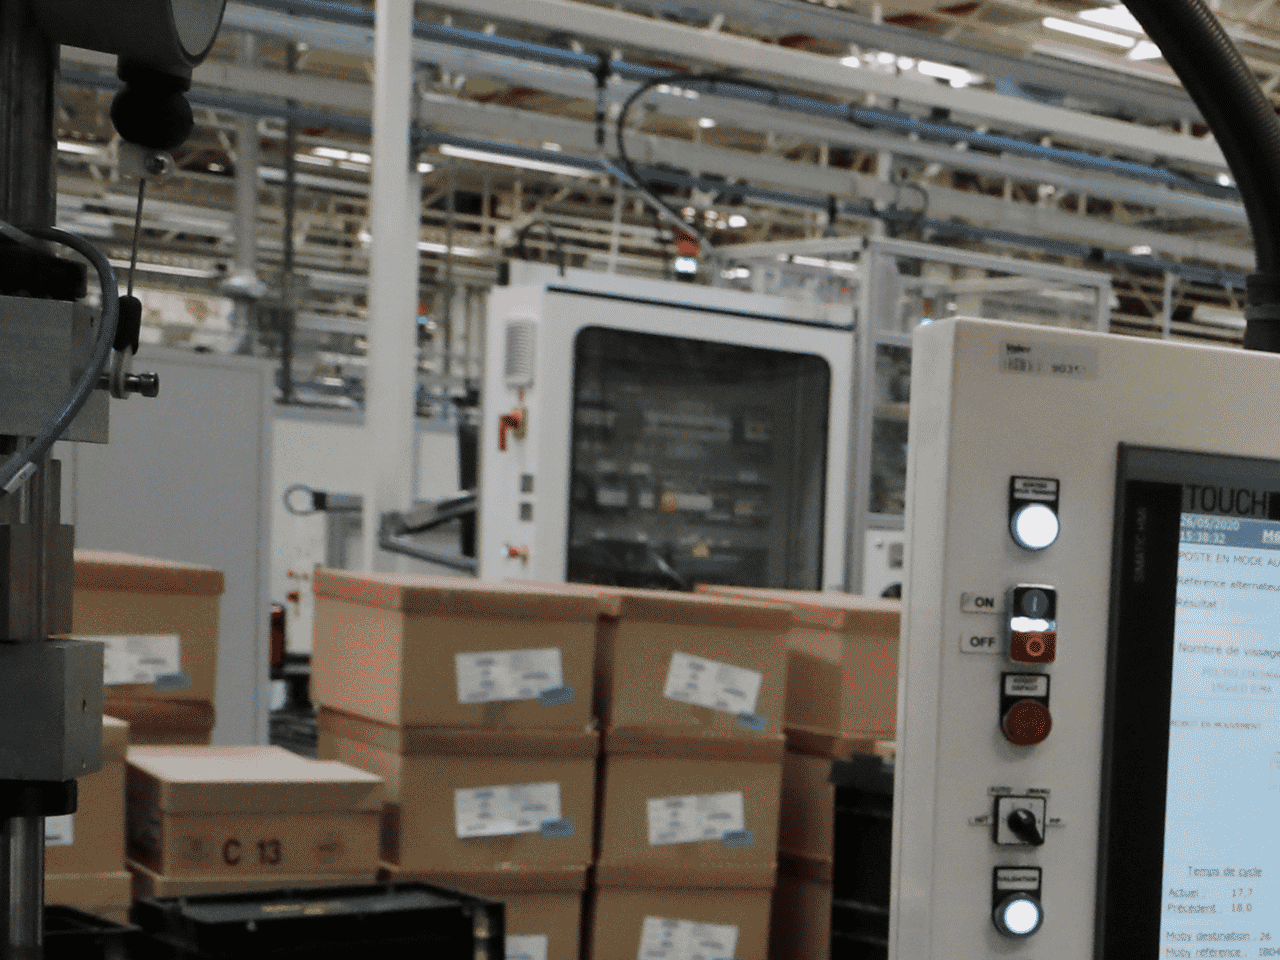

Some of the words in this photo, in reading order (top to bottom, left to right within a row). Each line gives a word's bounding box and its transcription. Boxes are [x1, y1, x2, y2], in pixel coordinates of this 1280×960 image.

[1189, 485, 1268, 517] TOUCH
[1178, 551, 1212, 562] POSTE
[1216, 553, 1230, 563] EN
[1234, 554, 1264, 567] MODE
[975, 597, 994, 608] ON
[970, 636, 996, 647] OFF
[1178, 642, 1222, 655] Nombre
[1226, 646, 1239, 655] de
[222, 838, 241, 866] C
[257, 838, 282, 866] 13
[1188, 865, 1220, 877] Temps
[1223, 865, 1236, 877] de
[1238, 866, 1263, 878] cycle
[1196, 931, 1250, 942] destination
